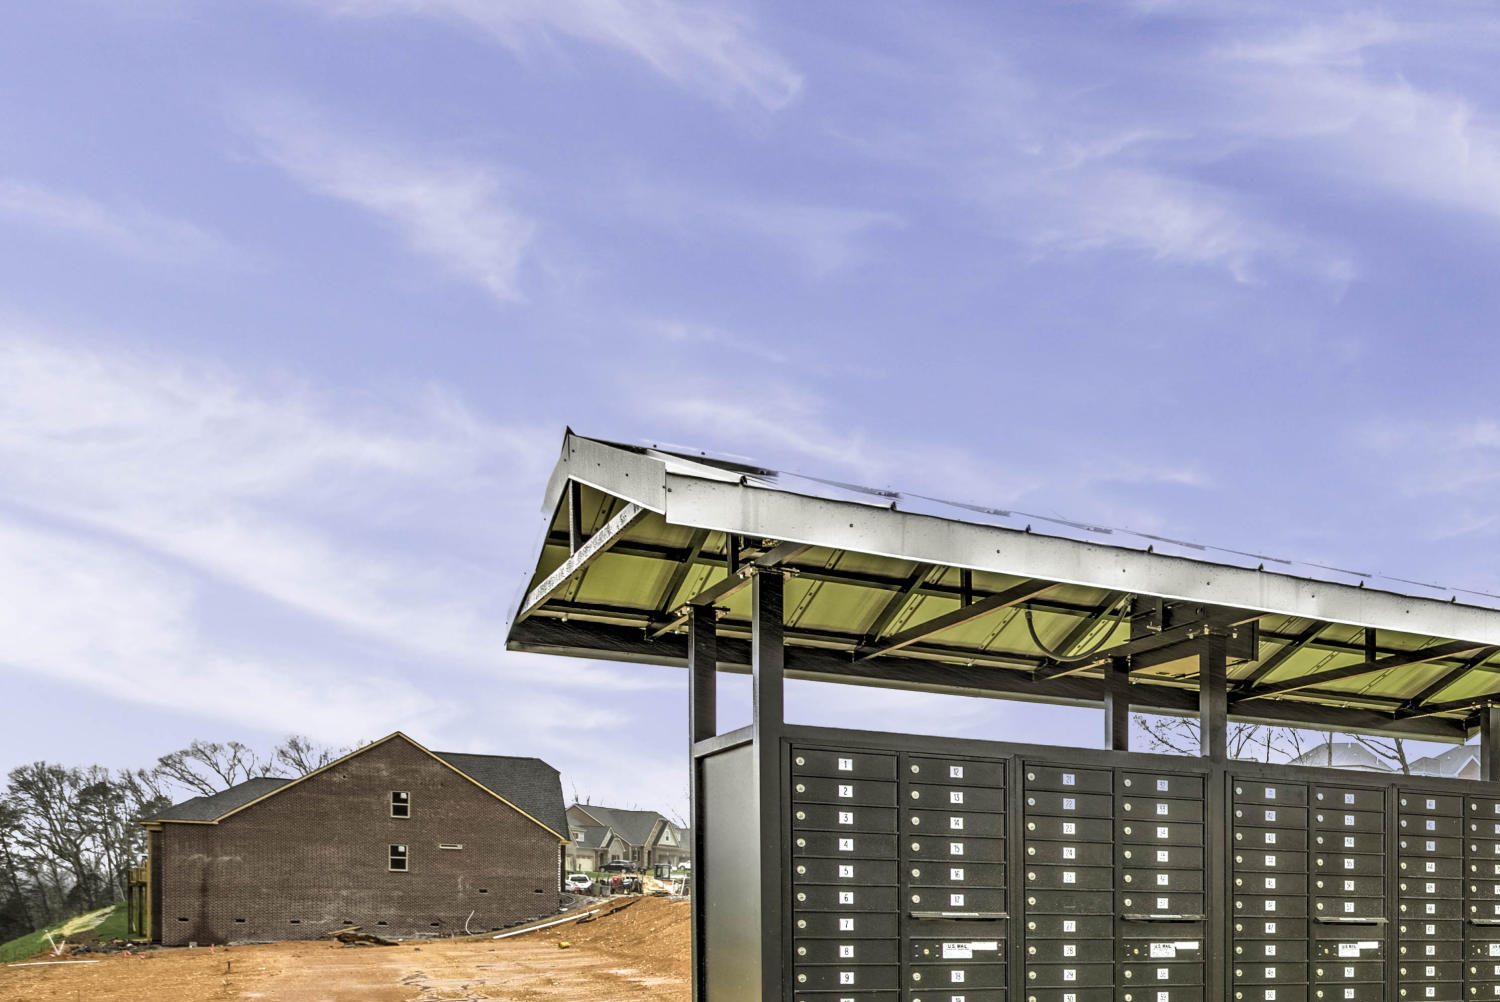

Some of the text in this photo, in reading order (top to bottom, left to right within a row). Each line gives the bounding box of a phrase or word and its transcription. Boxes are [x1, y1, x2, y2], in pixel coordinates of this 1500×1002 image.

[844, 760, 847, 768] 1
[843, 786, 848, 796] 2
[844, 813, 849, 822] 3
[844, 840, 848, 849] 4
[844, 867, 849, 876] 5
[844, 894, 849, 902] 6
[845, 920, 849, 928] 7
[844, 947, 849, 956] 8
[844, 973, 850, 982] 9
